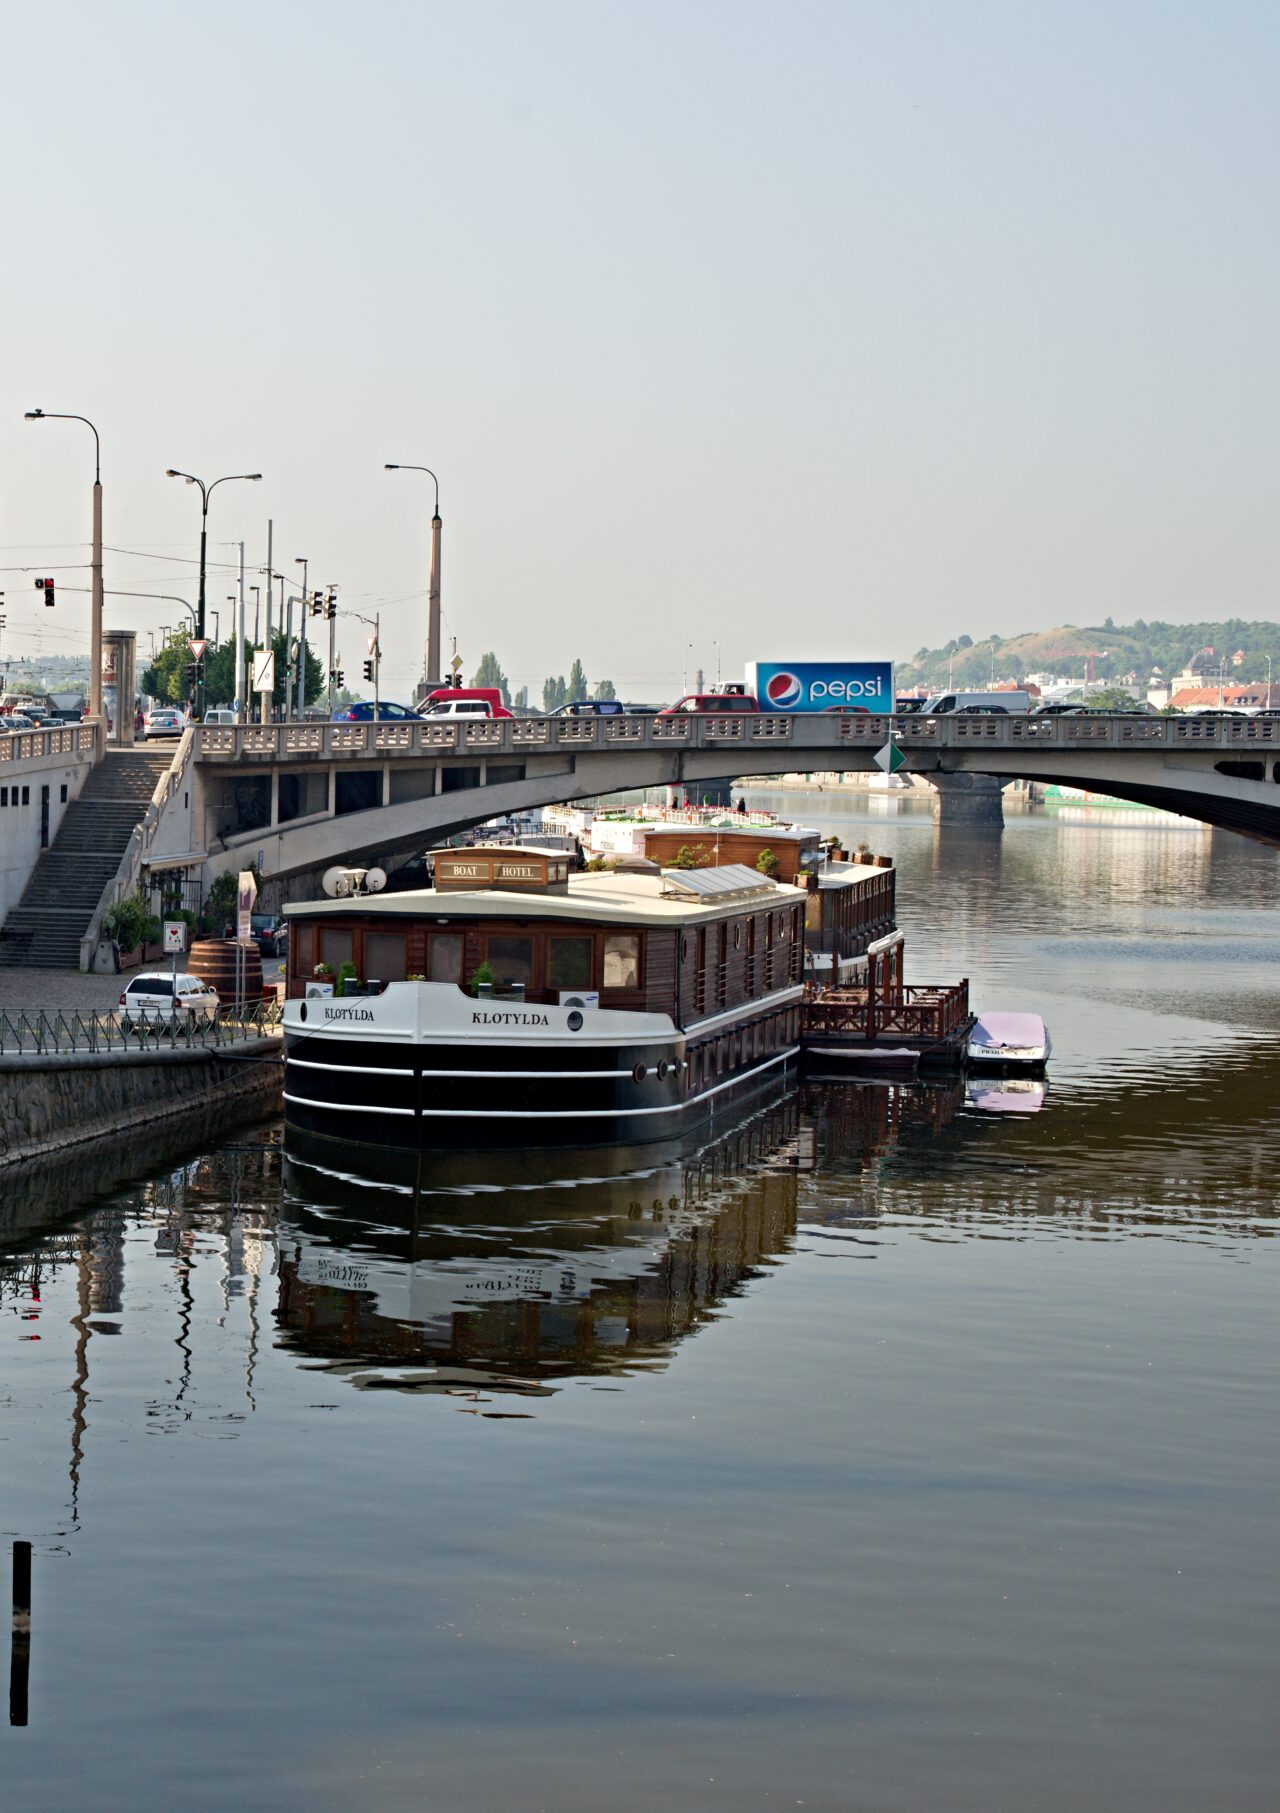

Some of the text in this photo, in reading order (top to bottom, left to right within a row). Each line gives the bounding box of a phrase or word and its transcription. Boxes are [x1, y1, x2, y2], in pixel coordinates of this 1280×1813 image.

[809, 676, 881, 701] pepsi
[453, 866, 534, 877] BOAT HOTEL
[325, 1007, 375, 1021] KLOTYLDA
[471, 1012, 550, 1026] KLOTYLDA
